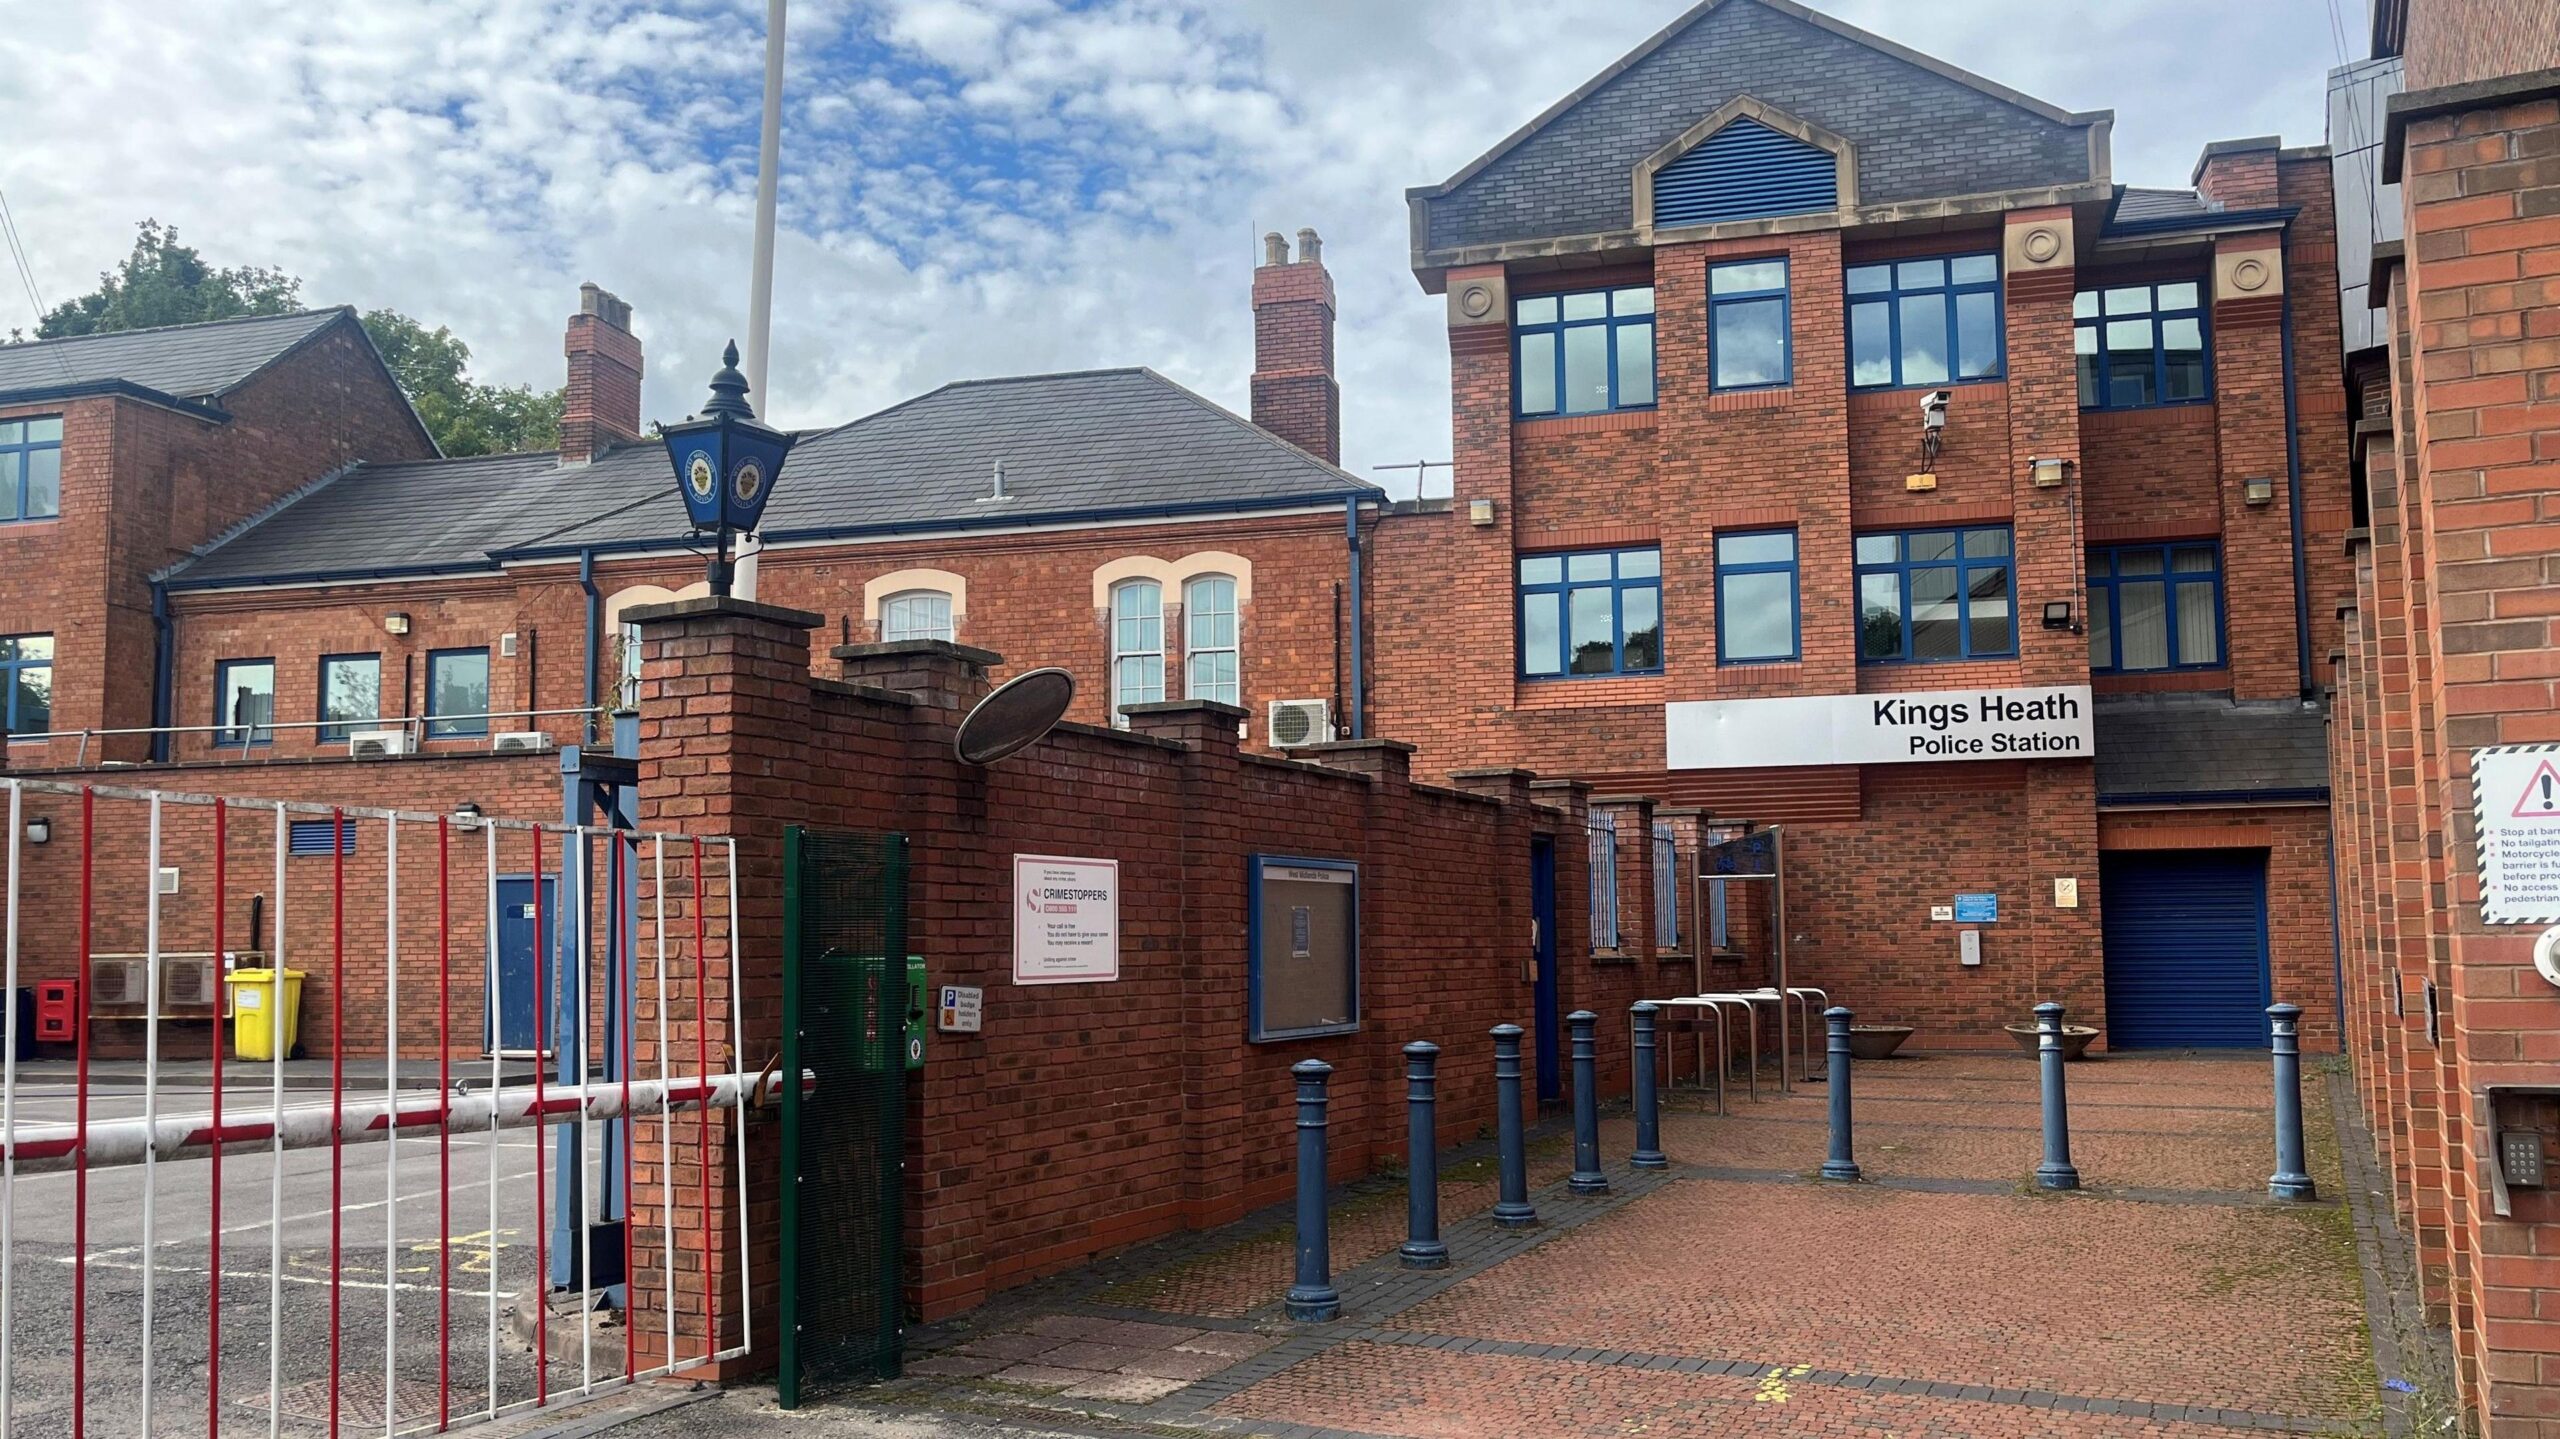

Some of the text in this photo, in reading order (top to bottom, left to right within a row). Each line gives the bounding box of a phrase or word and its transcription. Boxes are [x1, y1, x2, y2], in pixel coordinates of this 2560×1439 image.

[1874, 693, 2078, 731] Kings Heath
[1910, 732, 2080, 755] Police Station
[2501, 829, 2524, 837] Stop
[2519, 839, 2560, 848] tailgatin
[2502, 850, 2560, 858] Motorcycle
[2503, 872, 2536, 880] before
[1044, 888, 1107, 900] CRIMESTOPPERS
[2505, 895, 2560, 904] pedestrian
[958, 991, 980, 1000] Disabled
